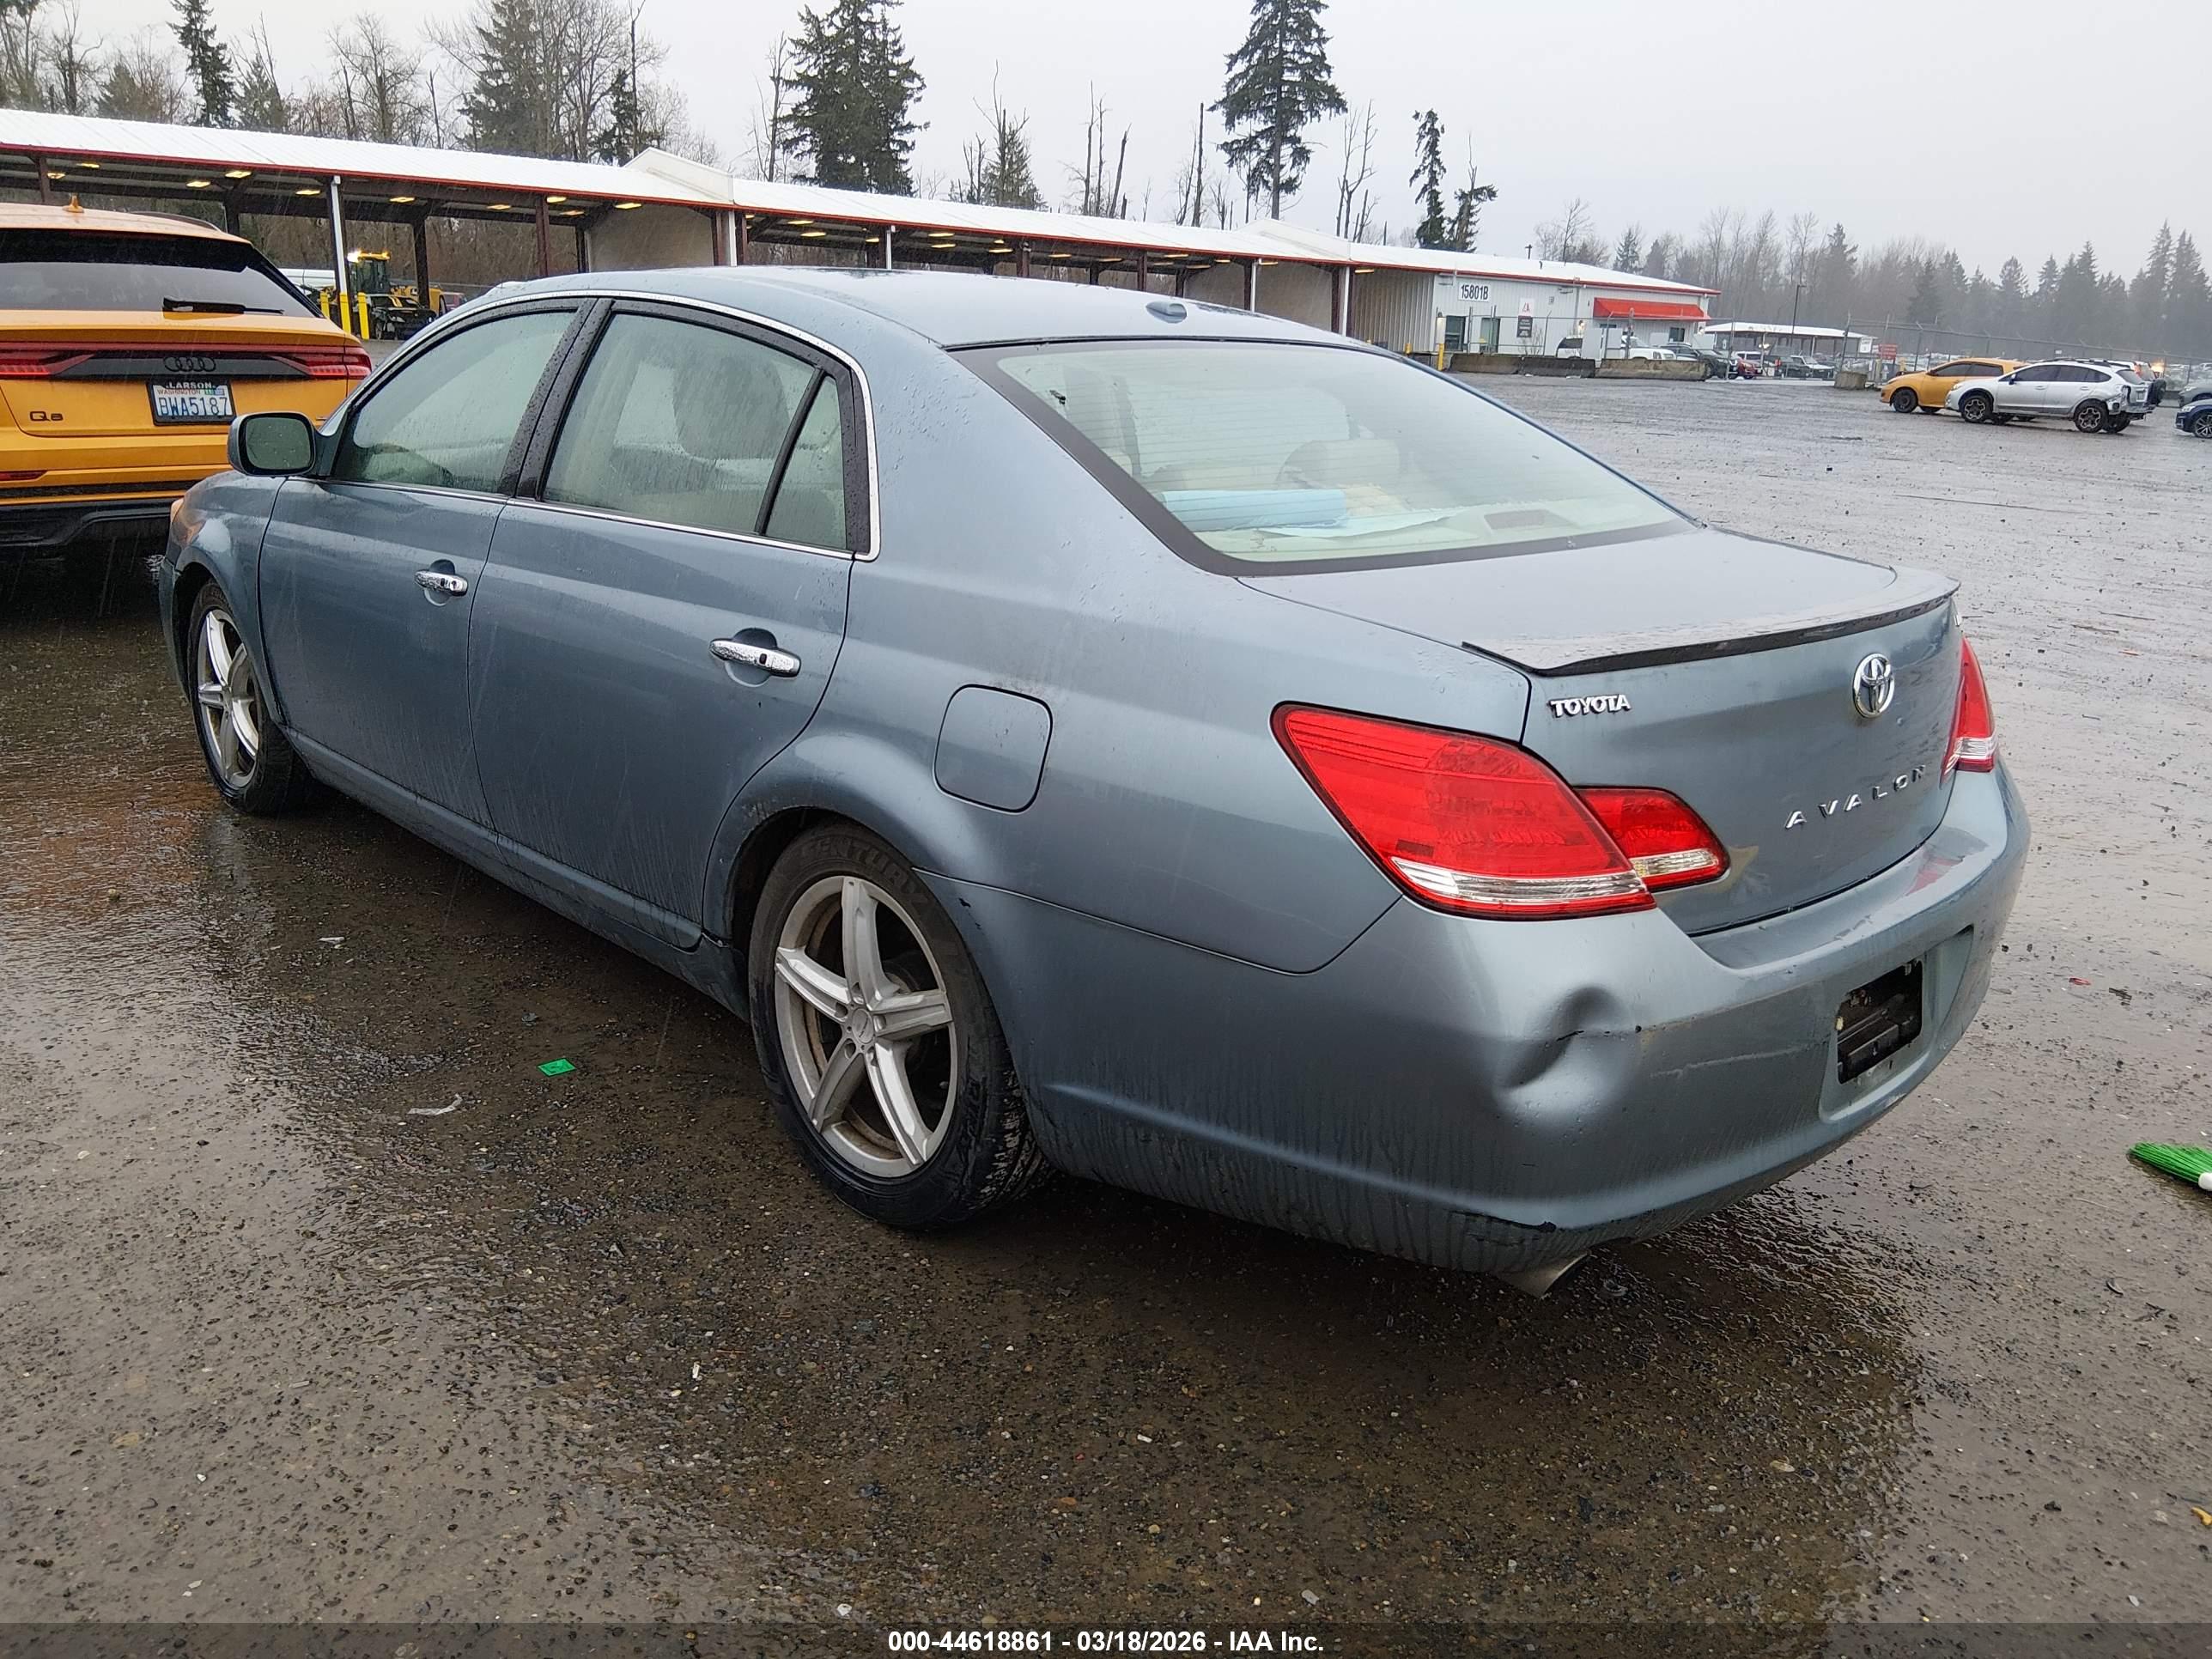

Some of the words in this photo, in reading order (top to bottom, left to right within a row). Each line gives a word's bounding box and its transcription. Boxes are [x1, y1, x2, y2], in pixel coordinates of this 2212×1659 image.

[1461, 284, 1489, 300] 15801B
[159, 397, 228, 416] BWA5187
[1549, 694, 1632, 718] TOYOTA
[1784, 764, 1927, 830] AVALON
